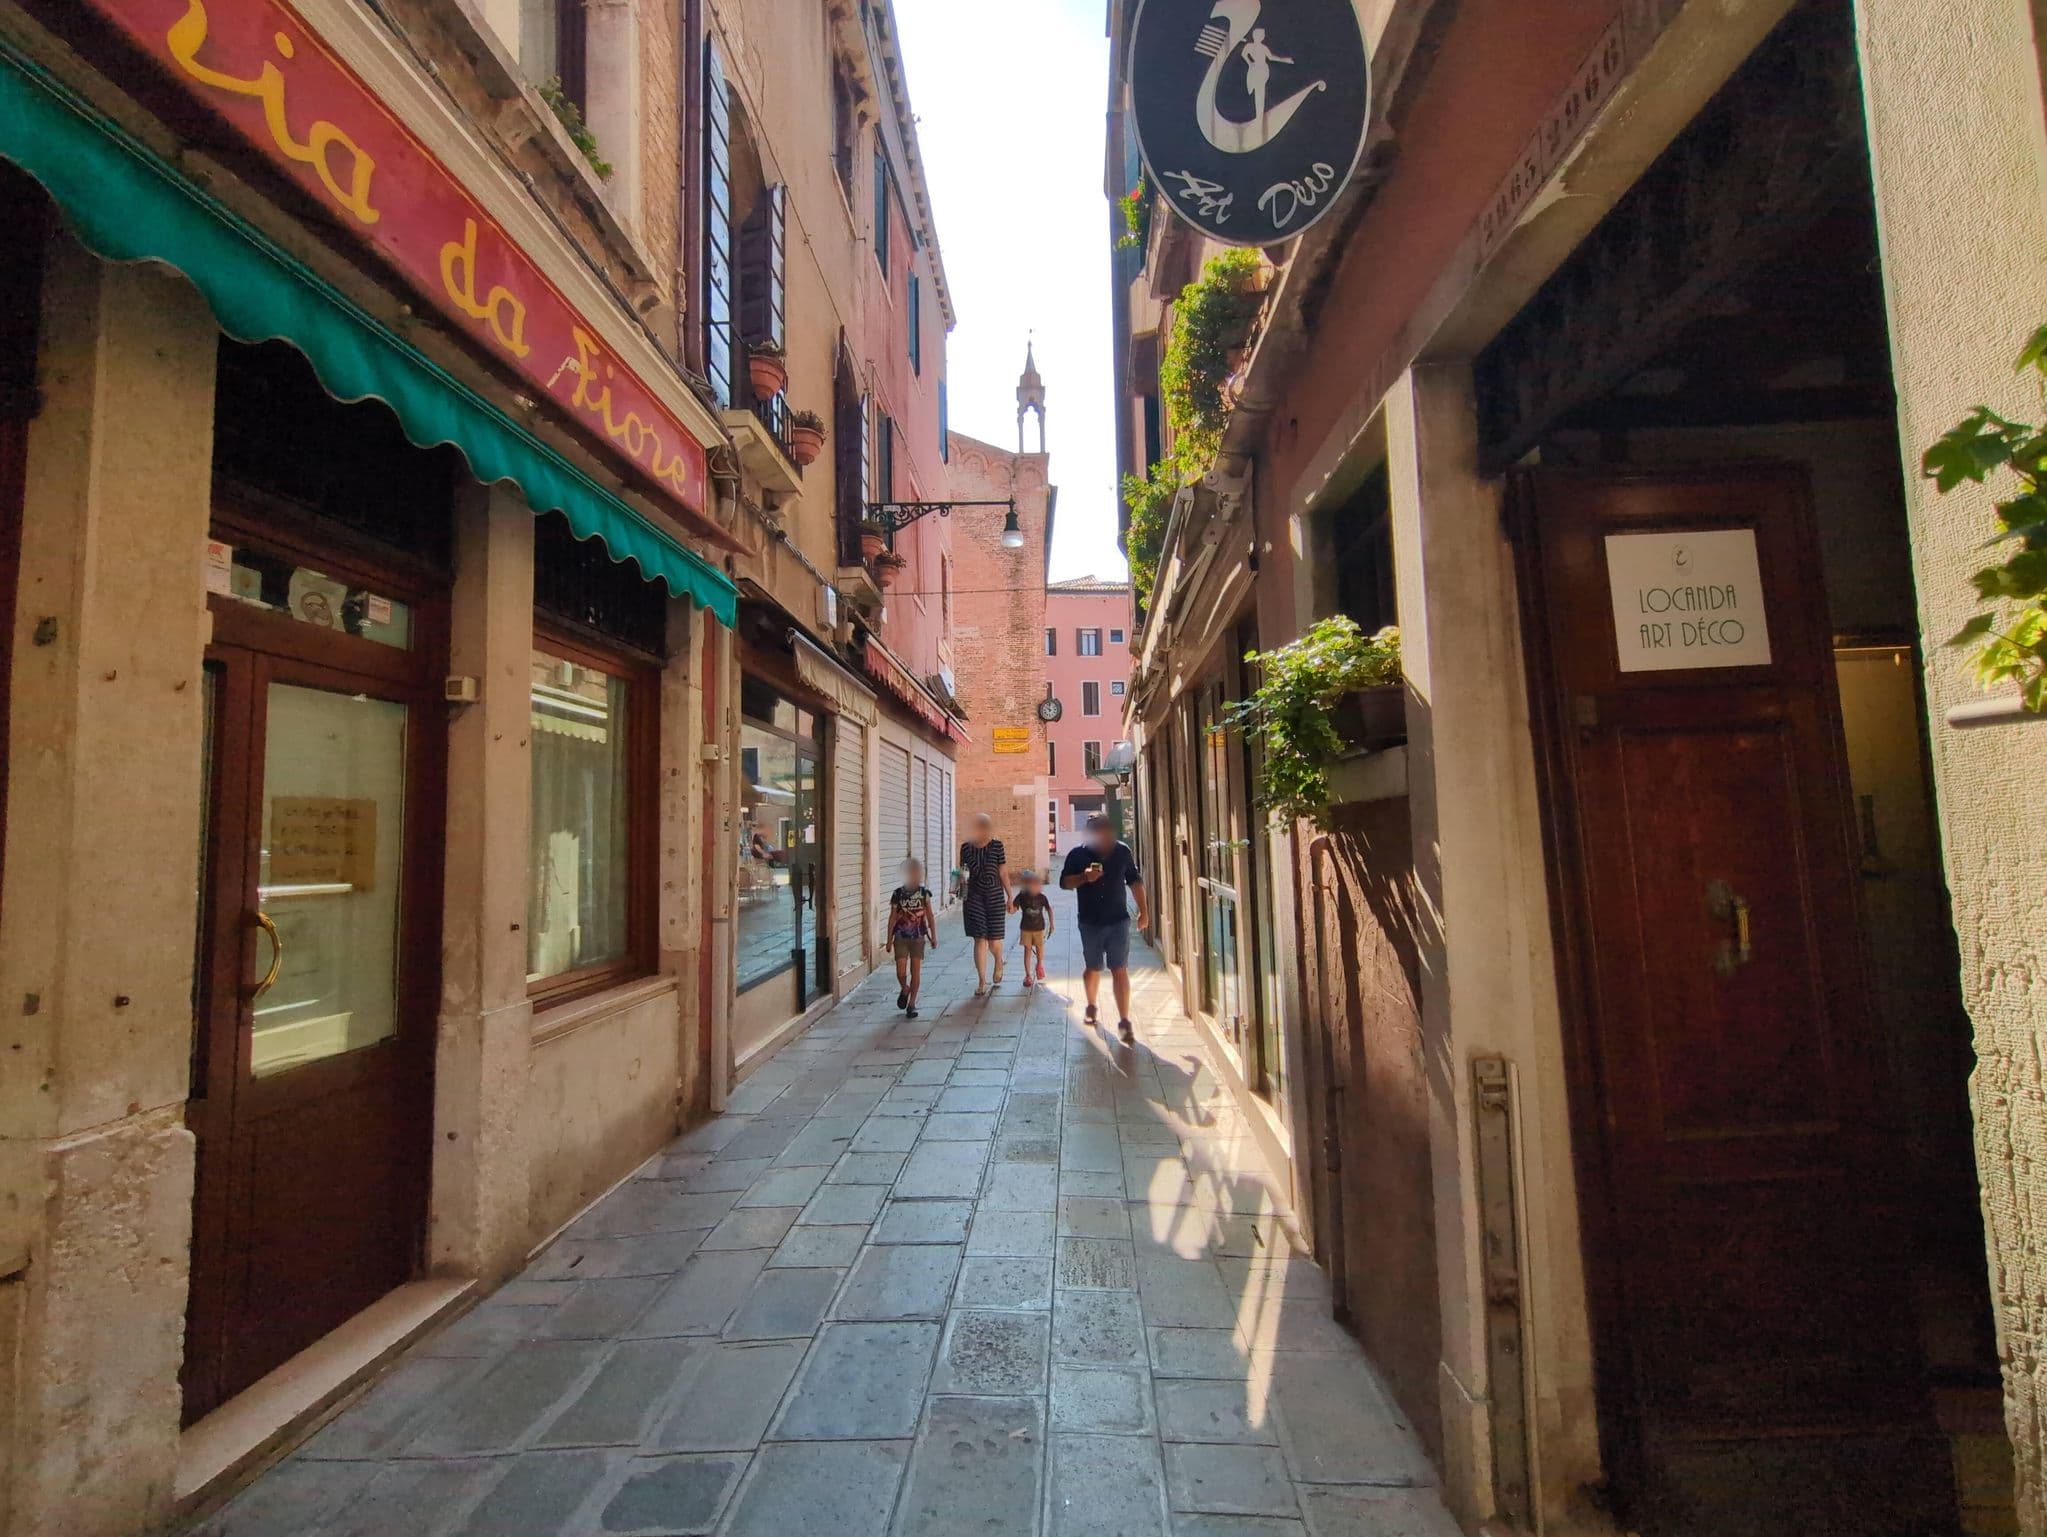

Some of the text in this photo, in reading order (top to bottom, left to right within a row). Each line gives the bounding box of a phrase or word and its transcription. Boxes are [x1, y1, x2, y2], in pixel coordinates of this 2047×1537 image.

[440, 218, 529, 358] da
[571, 325, 686, 496] Fiore
[1639, 584, 1737, 614] LOCANDA
[1640, 617, 1744, 649] ART DÉCO
